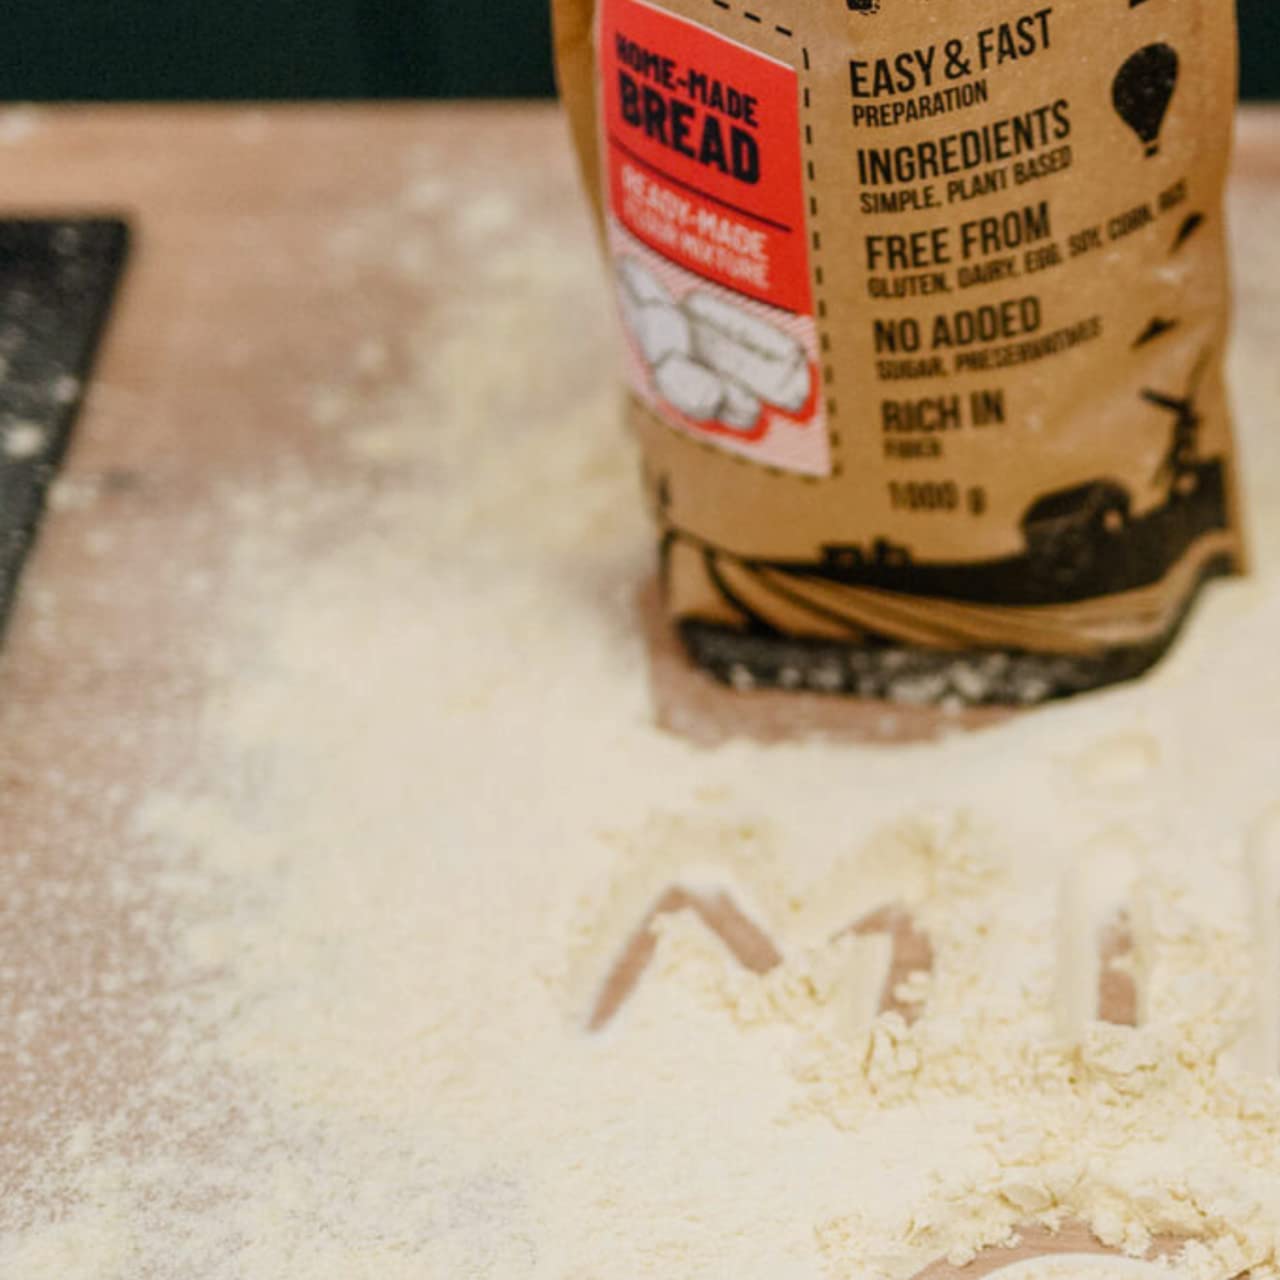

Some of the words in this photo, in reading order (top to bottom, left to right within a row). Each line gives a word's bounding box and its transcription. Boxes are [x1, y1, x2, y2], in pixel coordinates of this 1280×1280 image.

[615, 31, 759, 128] HOME-MADE
[849, 46, 936, 98] EASY
[944, 39, 972, 80] &
[977, 9, 1053, 70] FAST
[618, 68, 761, 185] BREAD
[852, 79, 988, 128] PREPARATION
[857, 99, 1071, 186] INGREDIENTS
[947, 168, 1007, 203] PLANT
[1013, 145, 1072, 185] BASED
[865, 227, 950, 270] FREE
[961, 201, 1050, 259] FROM
[873, 317, 921, 354] NO
[932, 296, 1041, 349] ADDED
[881, 394, 961, 433] RICH
[970, 389, 1005, 427] IN
